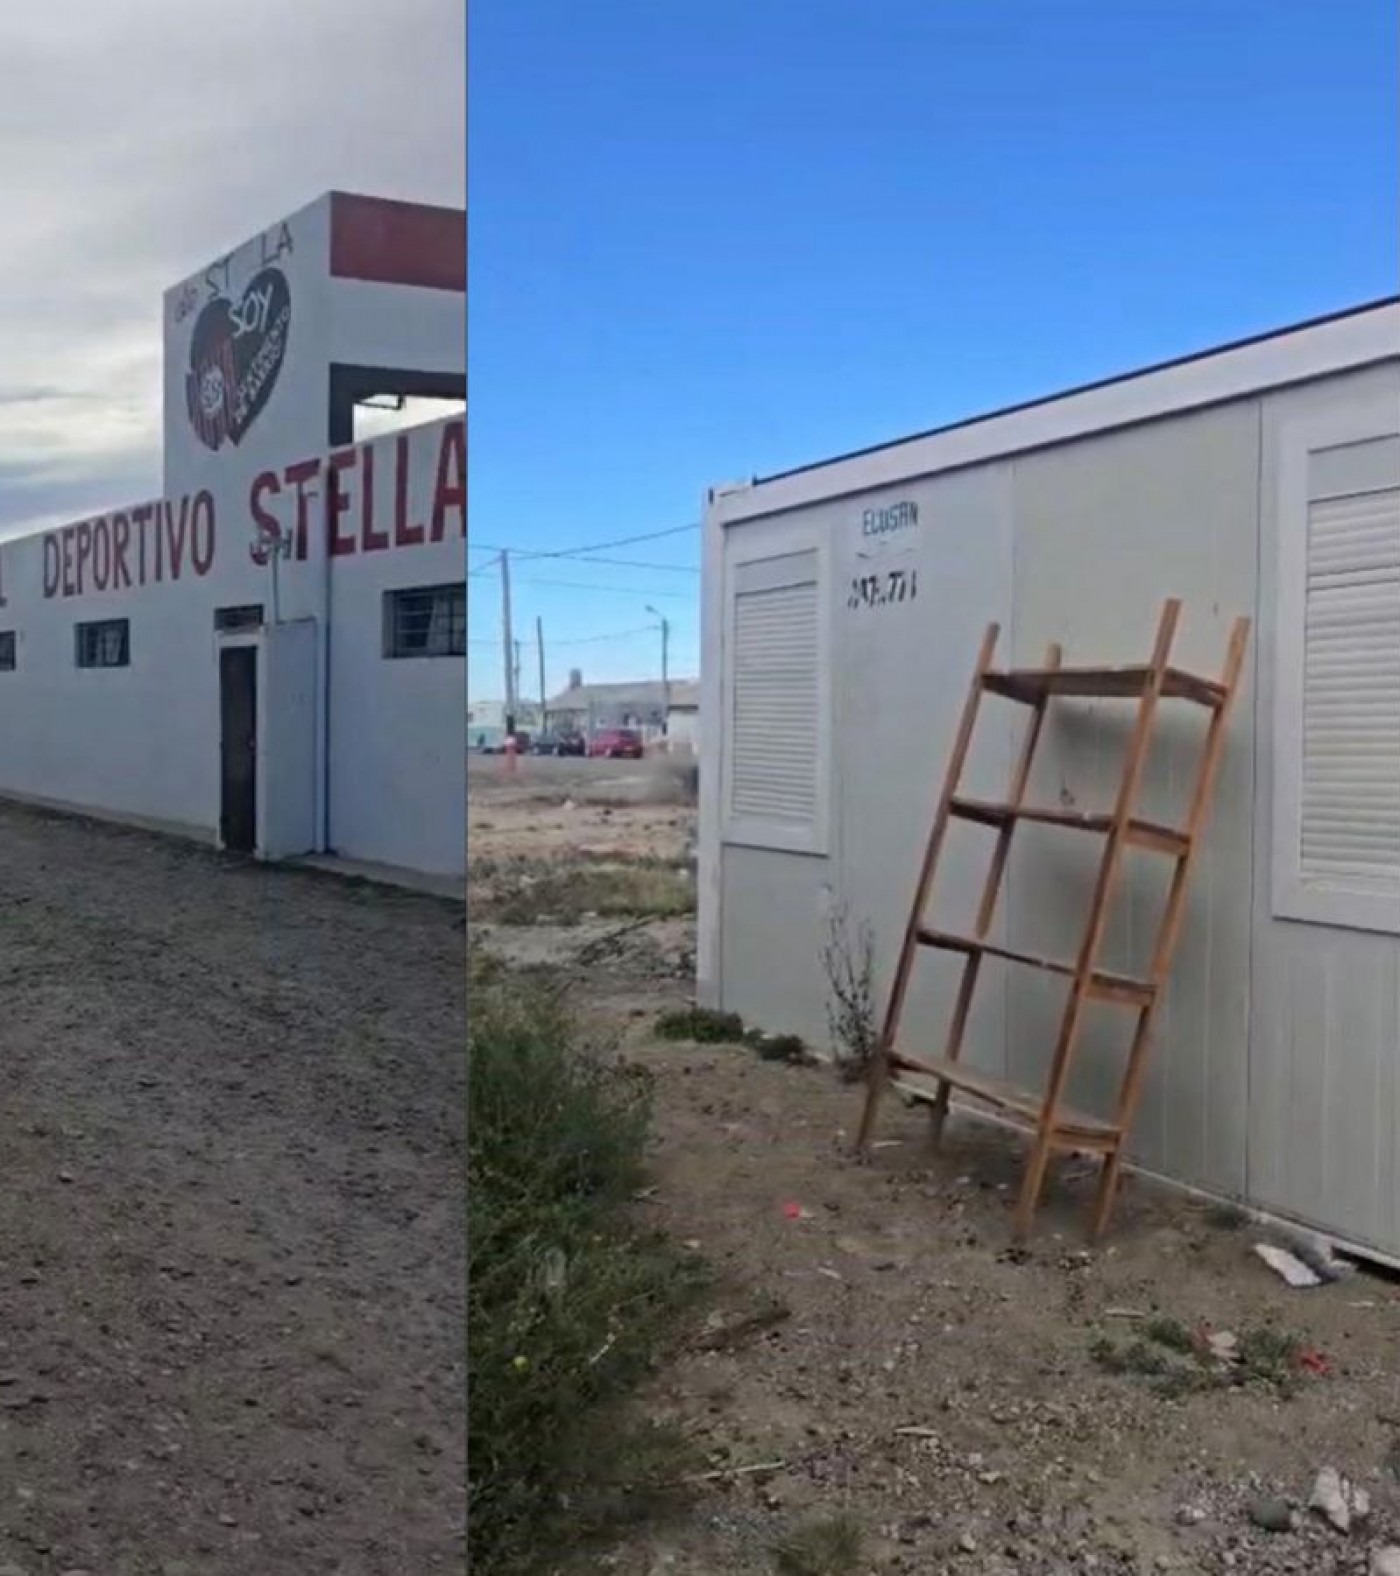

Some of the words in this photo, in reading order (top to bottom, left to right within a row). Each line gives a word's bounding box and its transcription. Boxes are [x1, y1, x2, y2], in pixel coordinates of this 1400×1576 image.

[228, 283, 274, 338] SOY
[43, 489, 216, 598] DEPORTIVO
[248, 420, 467, 566] STELLA
